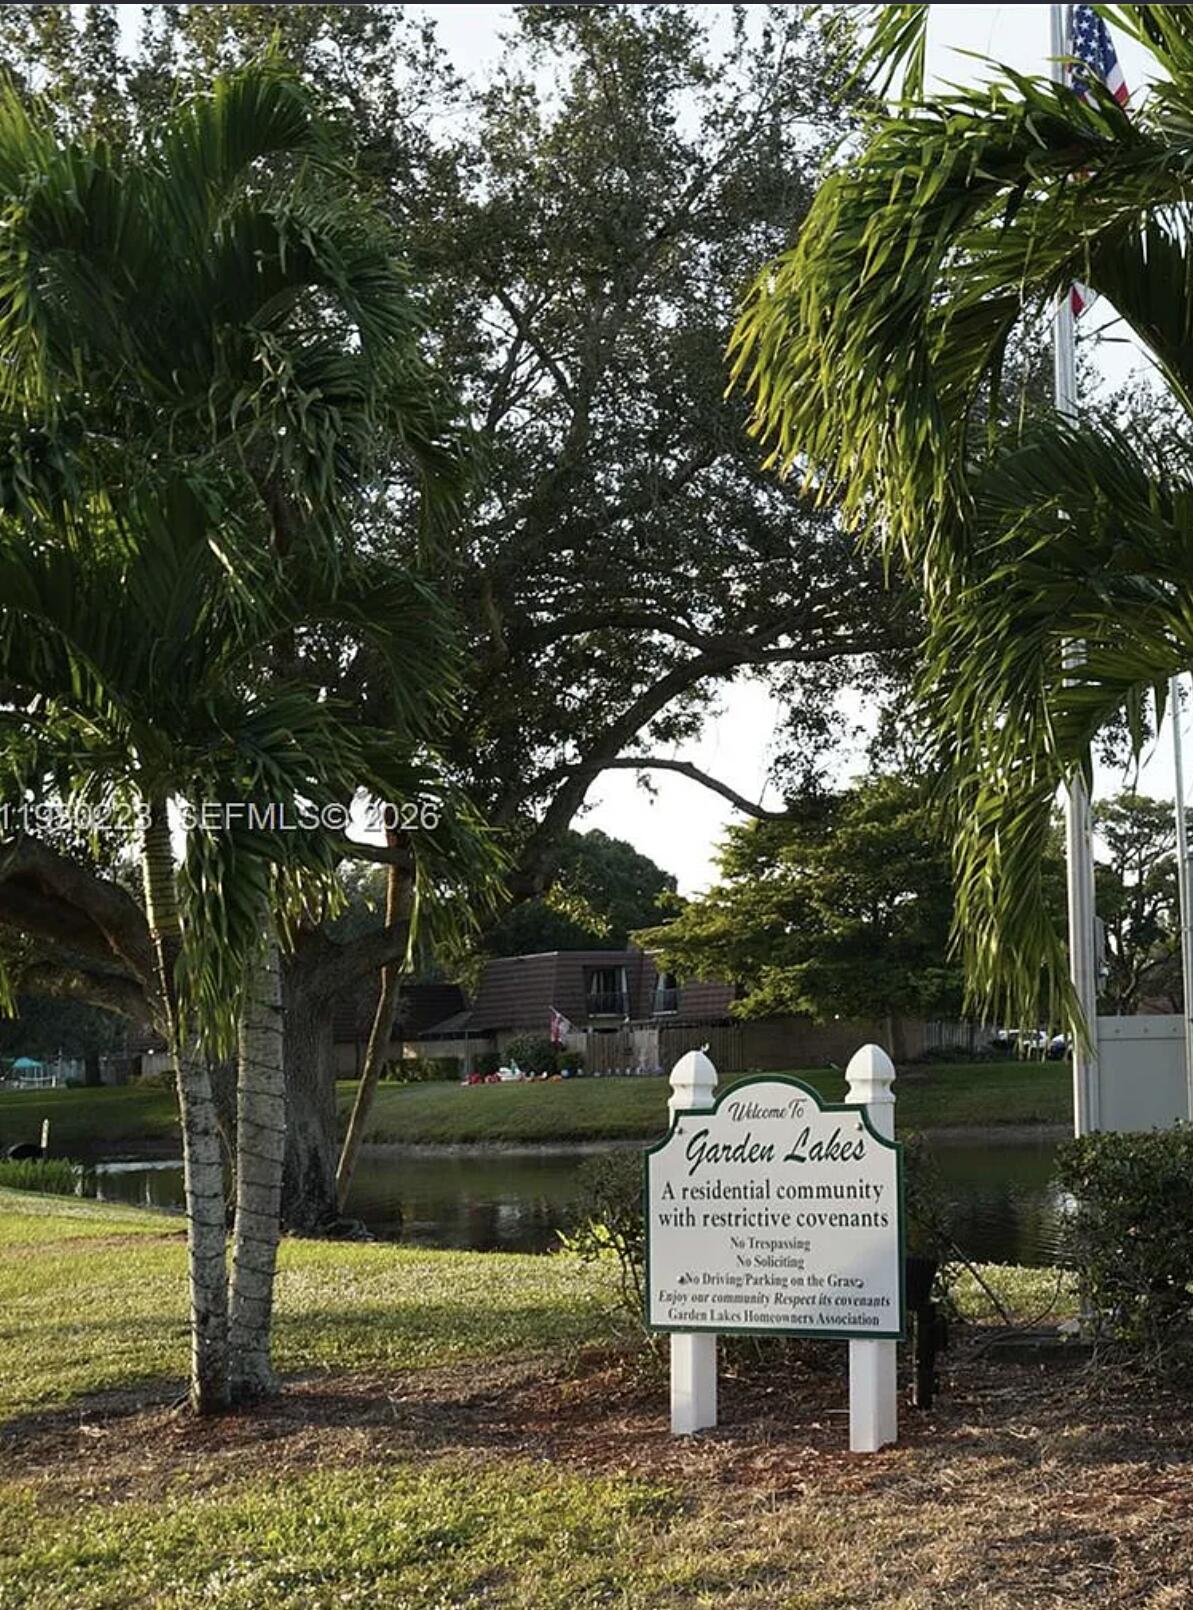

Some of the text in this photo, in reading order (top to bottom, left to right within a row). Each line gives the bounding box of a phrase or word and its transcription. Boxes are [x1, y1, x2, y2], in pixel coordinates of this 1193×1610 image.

[728, 1098, 807, 1122] Welcome To
[685, 1126, 866, 1176] Garden Lakes
[661, 1179, 884, 1203] A residential community
[658, 1207, 889, 1228] with restrictive covenants
[730, 1237, 811, 1252] No Trespassing
[737, 1255, 805, 1270] No Soliciting
[685, 1272, 700, 1286] No
[790, 1278, 804, 1287] on
[807, 1274, 825, 1287] the
[658, 1290, 891, 1308] Enjoy our community Respect its covenants
[668, 1308, 880, 1326] Garden Lakes Homeowners Association
